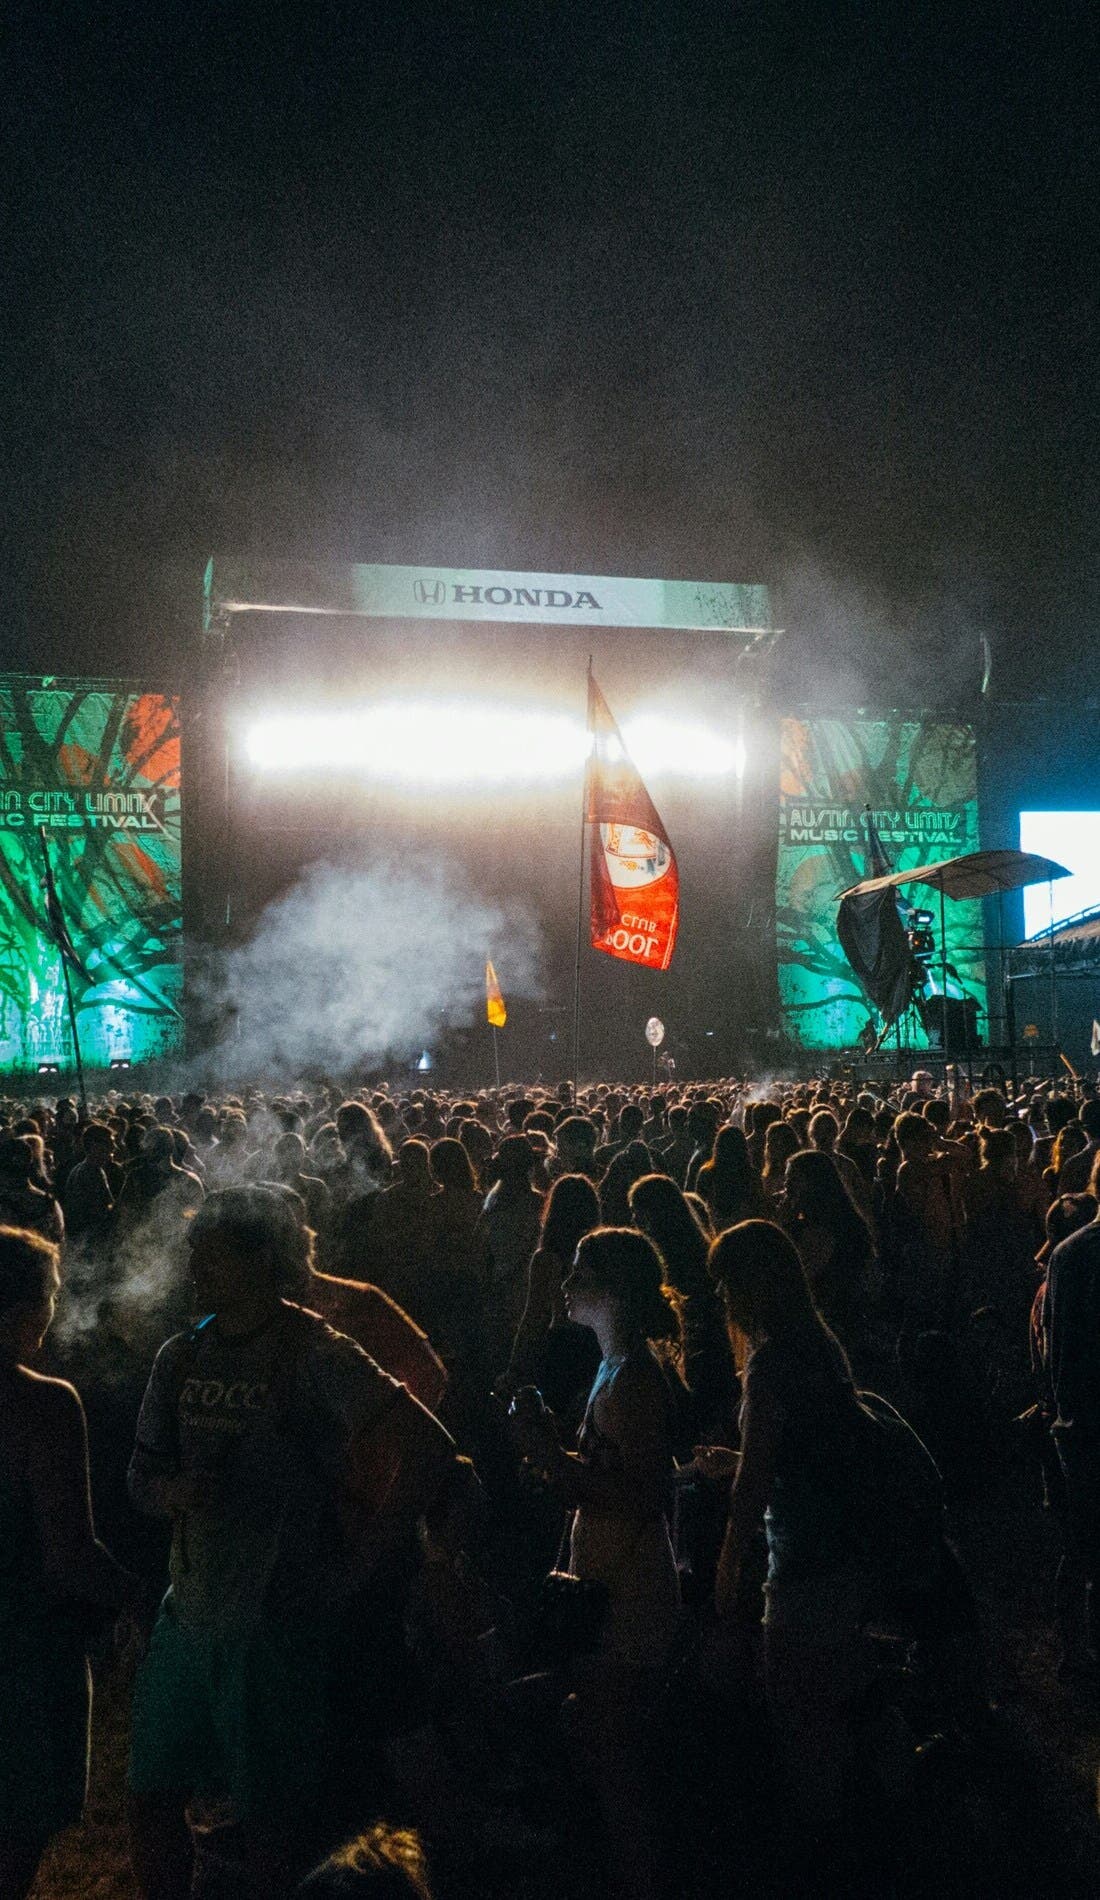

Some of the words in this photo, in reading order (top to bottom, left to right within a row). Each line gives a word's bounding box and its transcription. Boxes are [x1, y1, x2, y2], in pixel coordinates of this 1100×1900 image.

[452, 585, 603, 609] HONDA
[28, 791, 79, 811] CITY
[33, 813, 158, 828] FESTIVAL
[790, 809, 856, 828] AUSTIN
[905, 811, 961, 830] LIMITS
[790, 828, 858, 841] MUSIC
